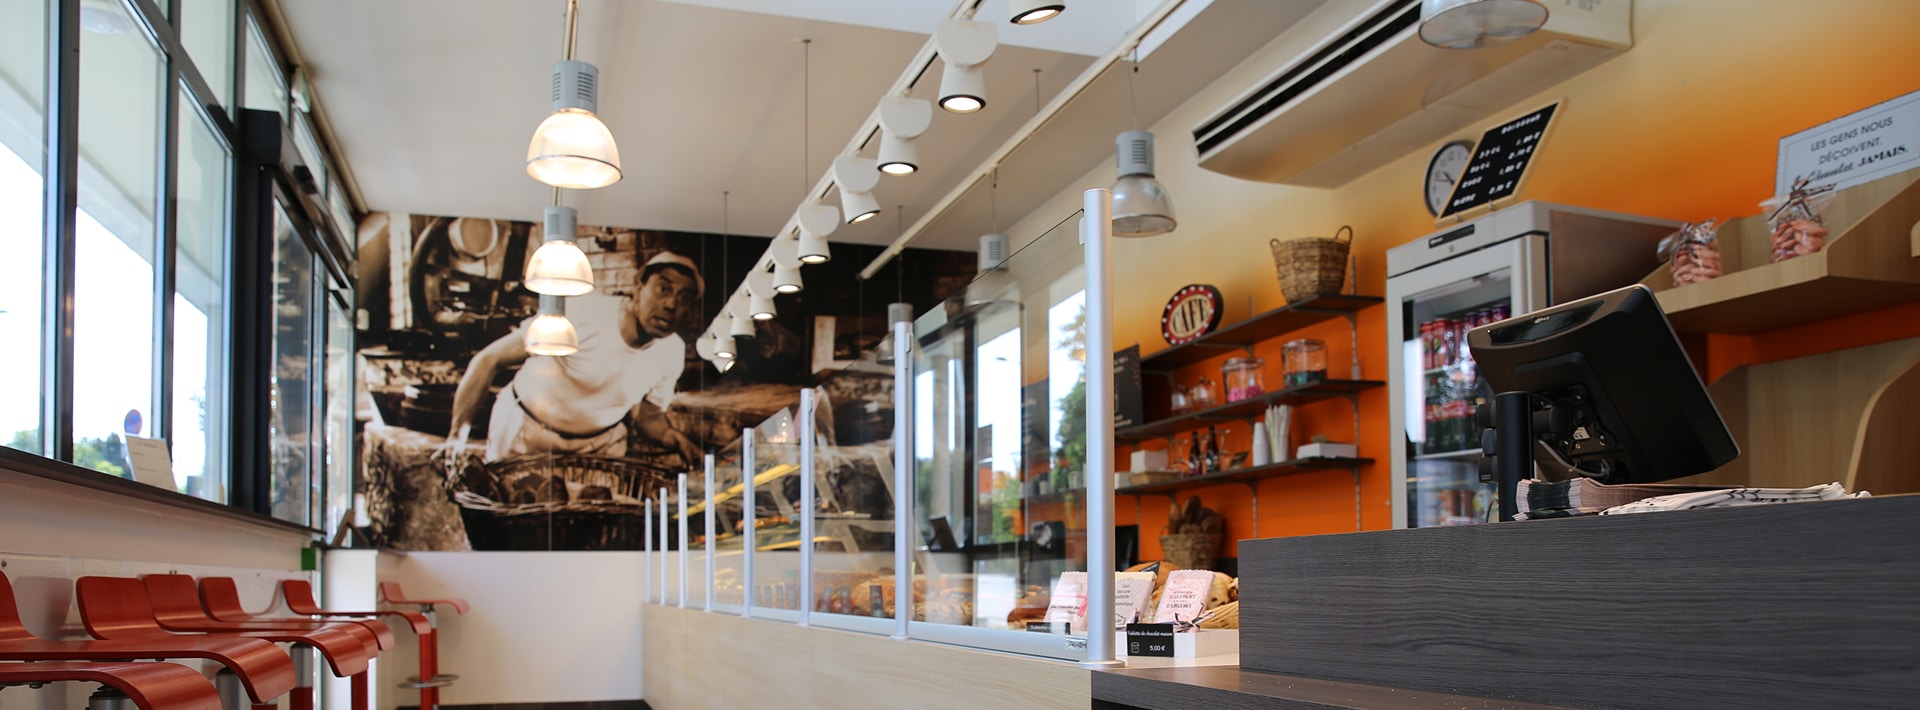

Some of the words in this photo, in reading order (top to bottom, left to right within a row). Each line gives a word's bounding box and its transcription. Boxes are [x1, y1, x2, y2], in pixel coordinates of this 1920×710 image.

[1810, 139, 1827, 152] LES
[1829, 128, 1859, 146] GENS
[1860, 116, 1894, 135] NOUS
[1857, 144, 1908, 167] JAMAIS.
